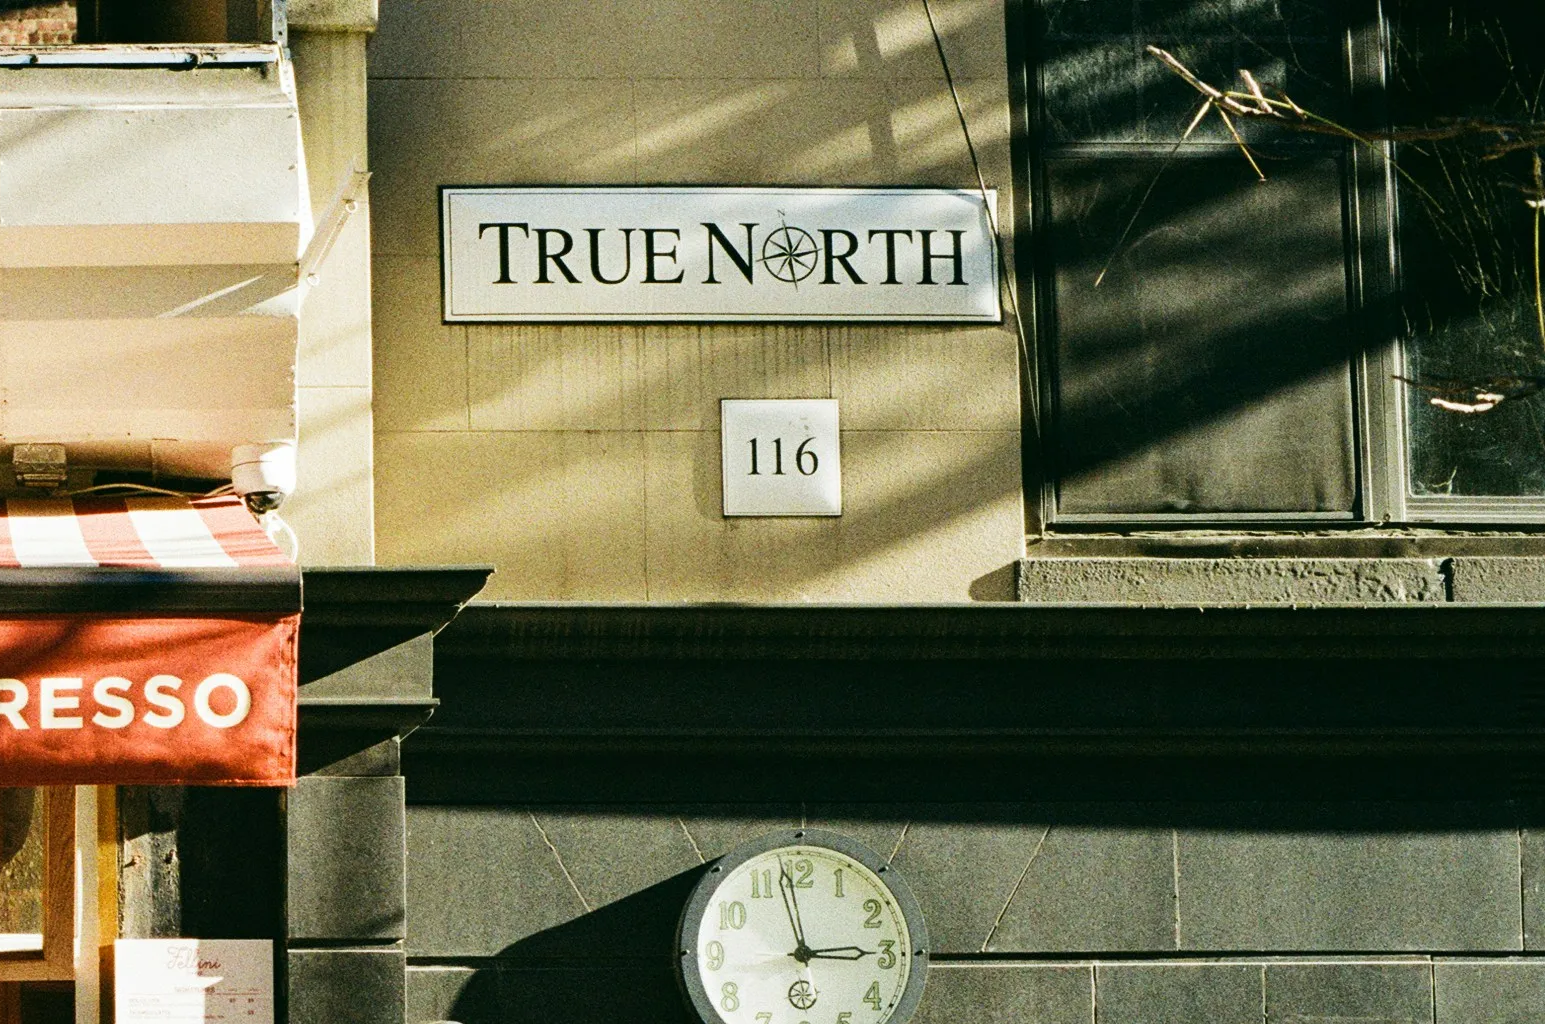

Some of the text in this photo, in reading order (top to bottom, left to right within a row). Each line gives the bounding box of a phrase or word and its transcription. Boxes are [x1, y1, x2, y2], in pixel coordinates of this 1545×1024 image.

[479, 221, 685, 285] TRUE
[747, 435, 820, 477] 116
[750, 868, 774, 899] 11
[833, 868, 845, 898] 1
[718, 900, 747, 930] 10
[863, 898, 882, 929] 2
[705, 940, 725, 971] 9
[877, 939, 897, 970] 3
[720, 981, 740, 1012] 8
[862, 980, 882, 1011] 4
